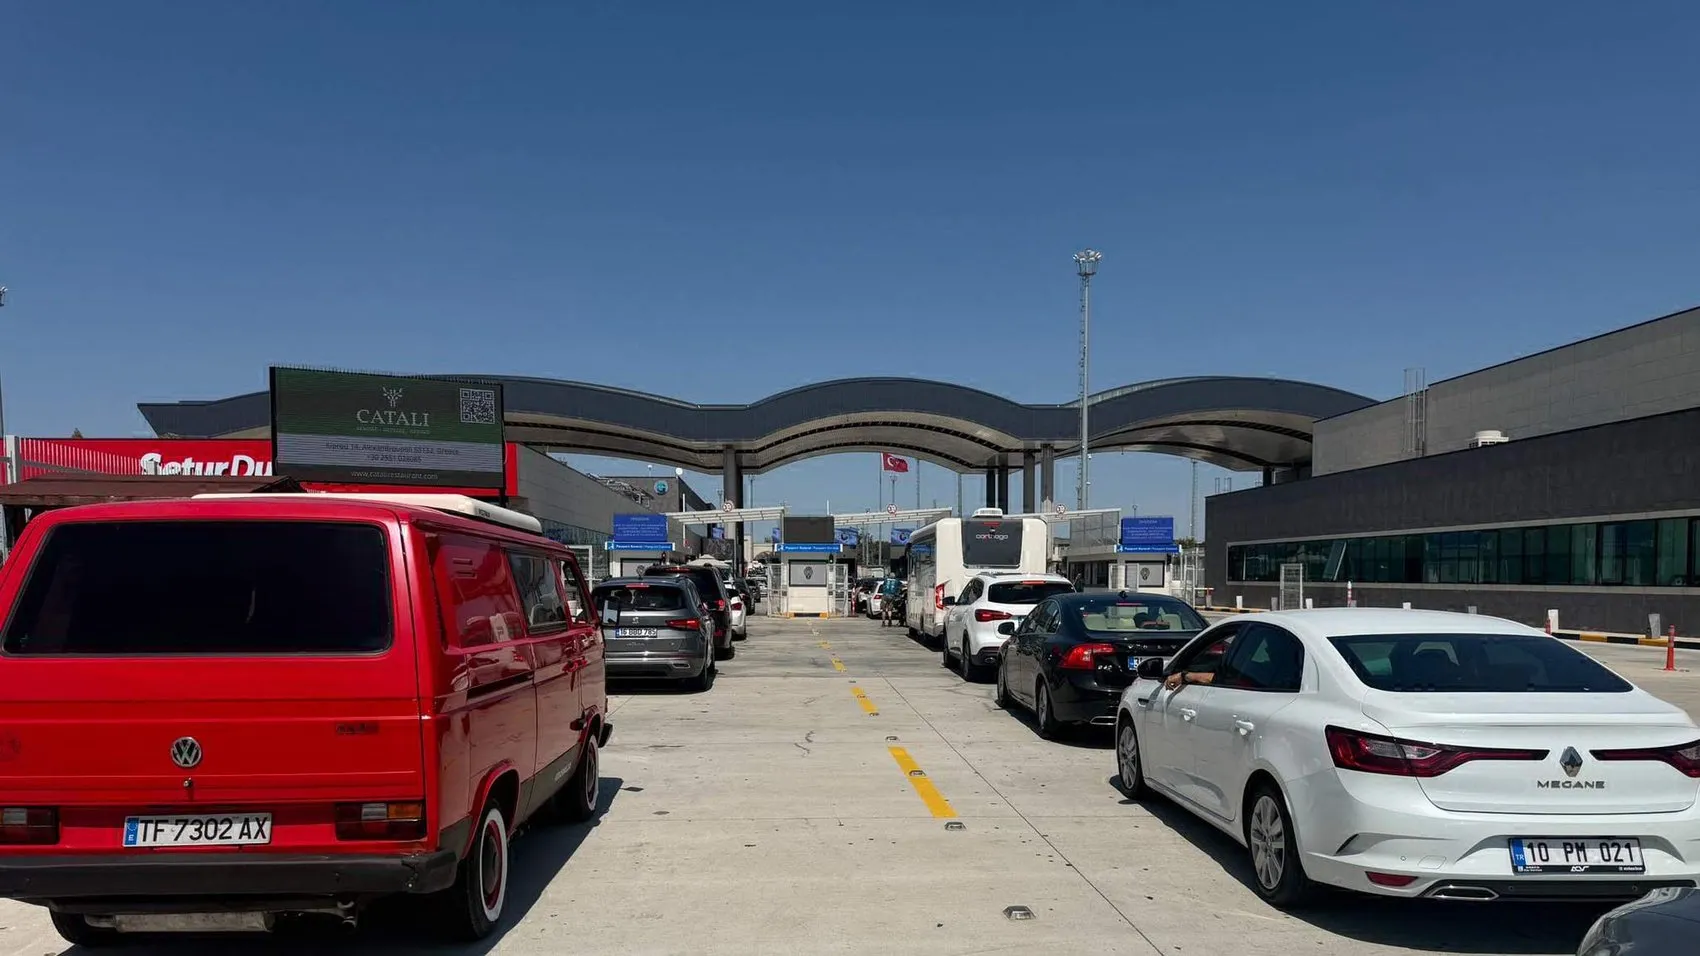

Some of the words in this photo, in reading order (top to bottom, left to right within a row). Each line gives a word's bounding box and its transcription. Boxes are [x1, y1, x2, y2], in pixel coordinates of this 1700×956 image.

[356, 409, 430, 427] CATALI
[1537, 780, 1605, 789] MEGANE
[140, 819, 169, 842] TF
[173, 817, 233, 841] 7302
[238, 816, 268, 840] AX
[1527, 842, 1549, 862] 10
[1563, 842, 1587, 862] PM
[1600, 842, 1634, 862] 021
